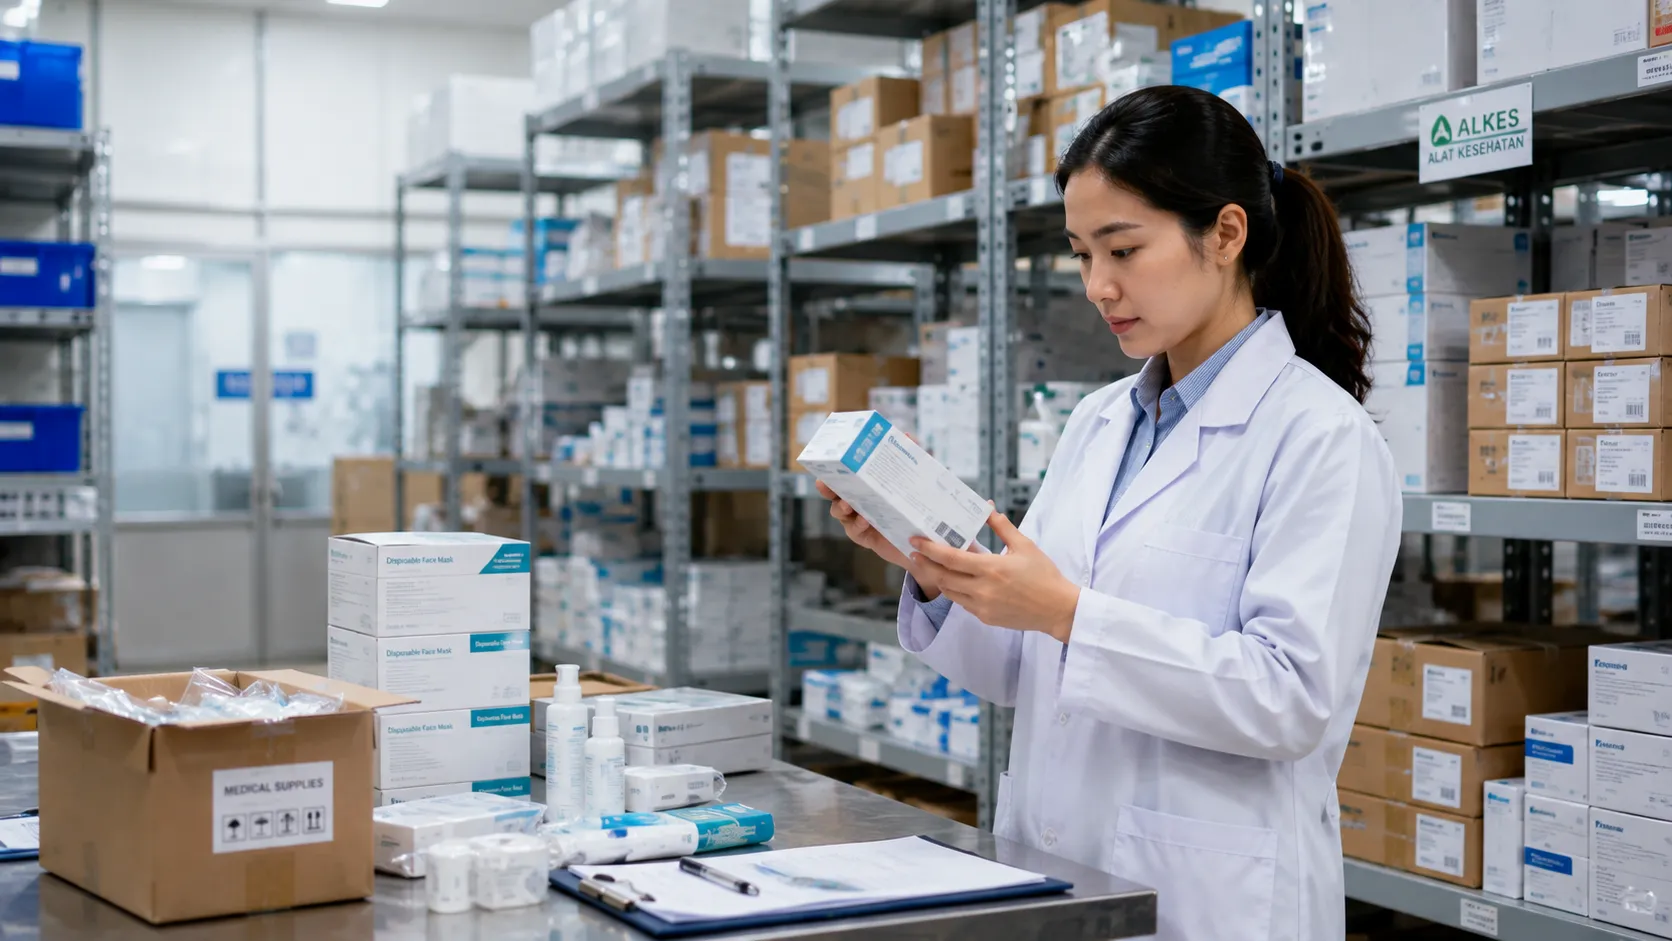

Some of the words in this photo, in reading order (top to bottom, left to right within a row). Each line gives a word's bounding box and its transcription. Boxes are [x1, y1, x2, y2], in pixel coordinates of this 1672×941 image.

[1457, 108, 1520, 137] ALKES
[1428, 149, 1454, 164] ALAT
[1458, 136, 1524, 159] KESEHATAN
[437, 555, 454, 563] Mask
[224, 782, 271, 797] MEDICAL
[274, 777, 324, 792] SUPPLIES
